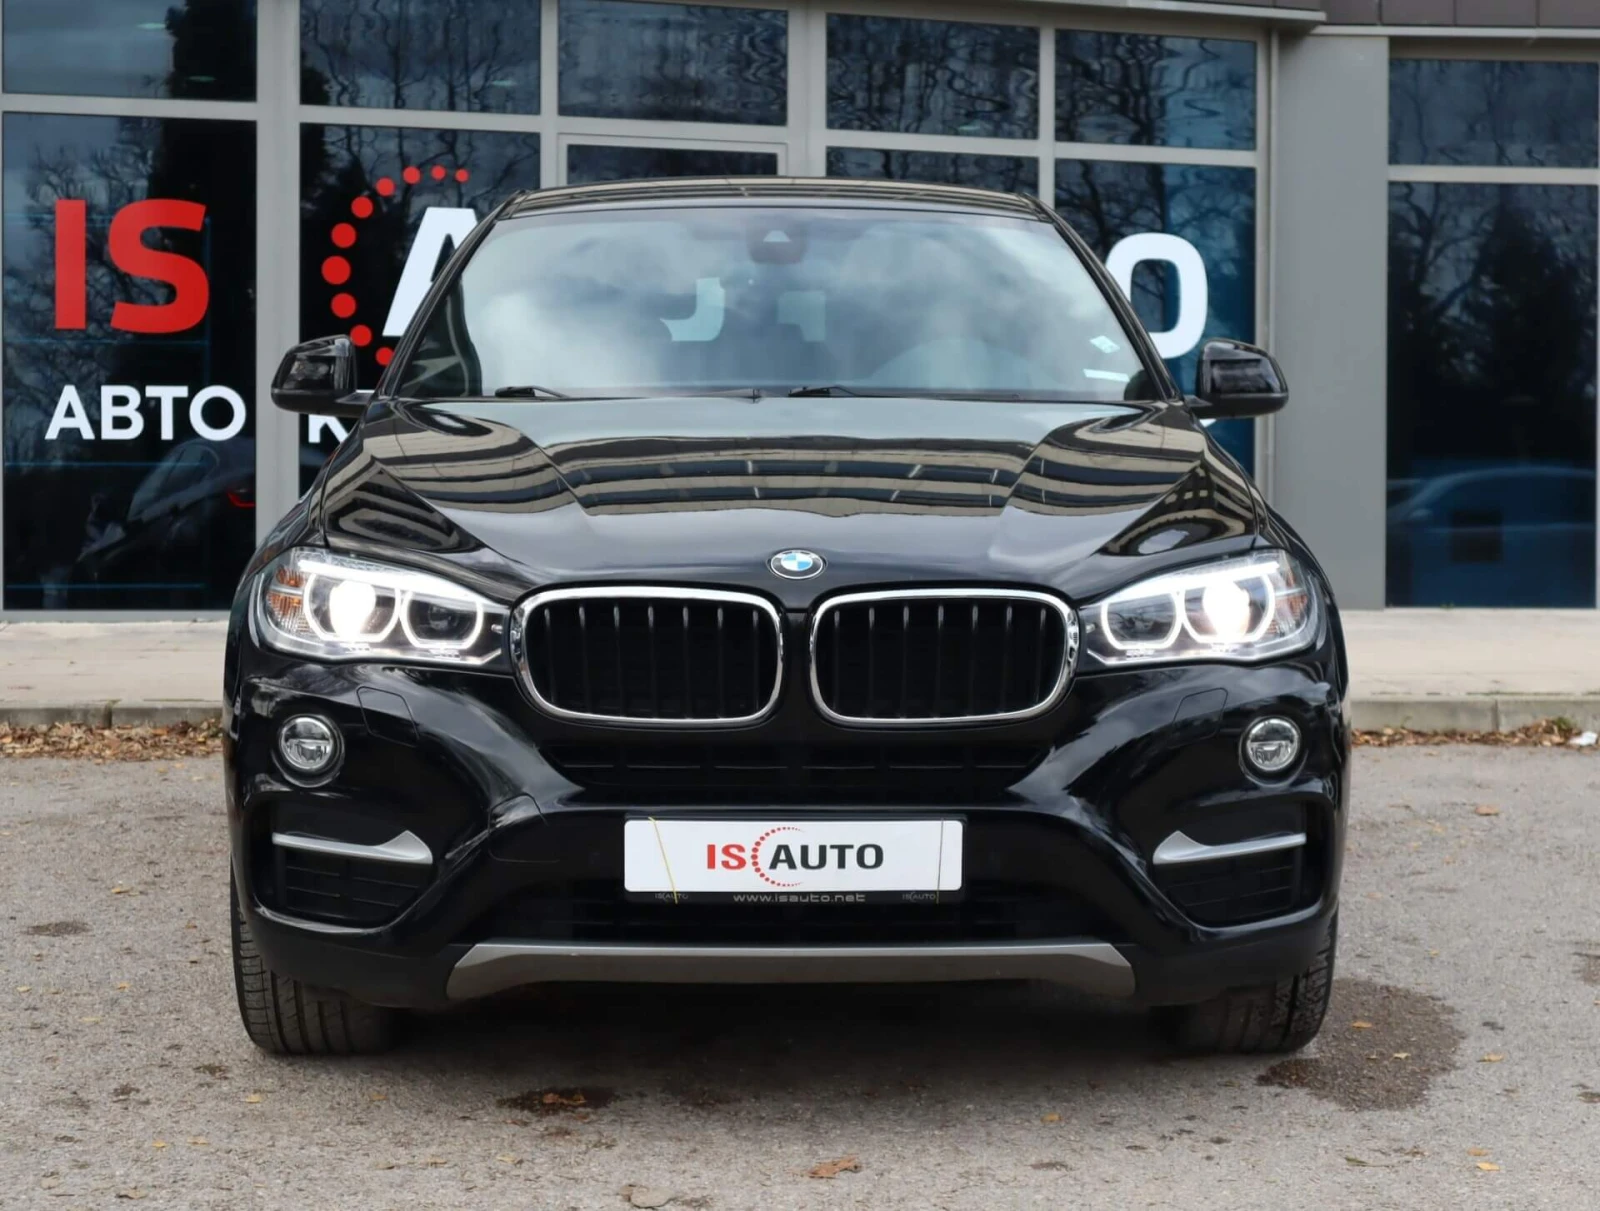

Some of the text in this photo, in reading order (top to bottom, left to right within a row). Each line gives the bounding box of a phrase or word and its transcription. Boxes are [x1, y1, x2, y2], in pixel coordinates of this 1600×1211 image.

[55, 199, 209, 333] IS
[45, 385, 246, 441] АВТО
[706, 843, 884, 870] IS AUTO
[733, 892, 866, 903] www.isauto.net
